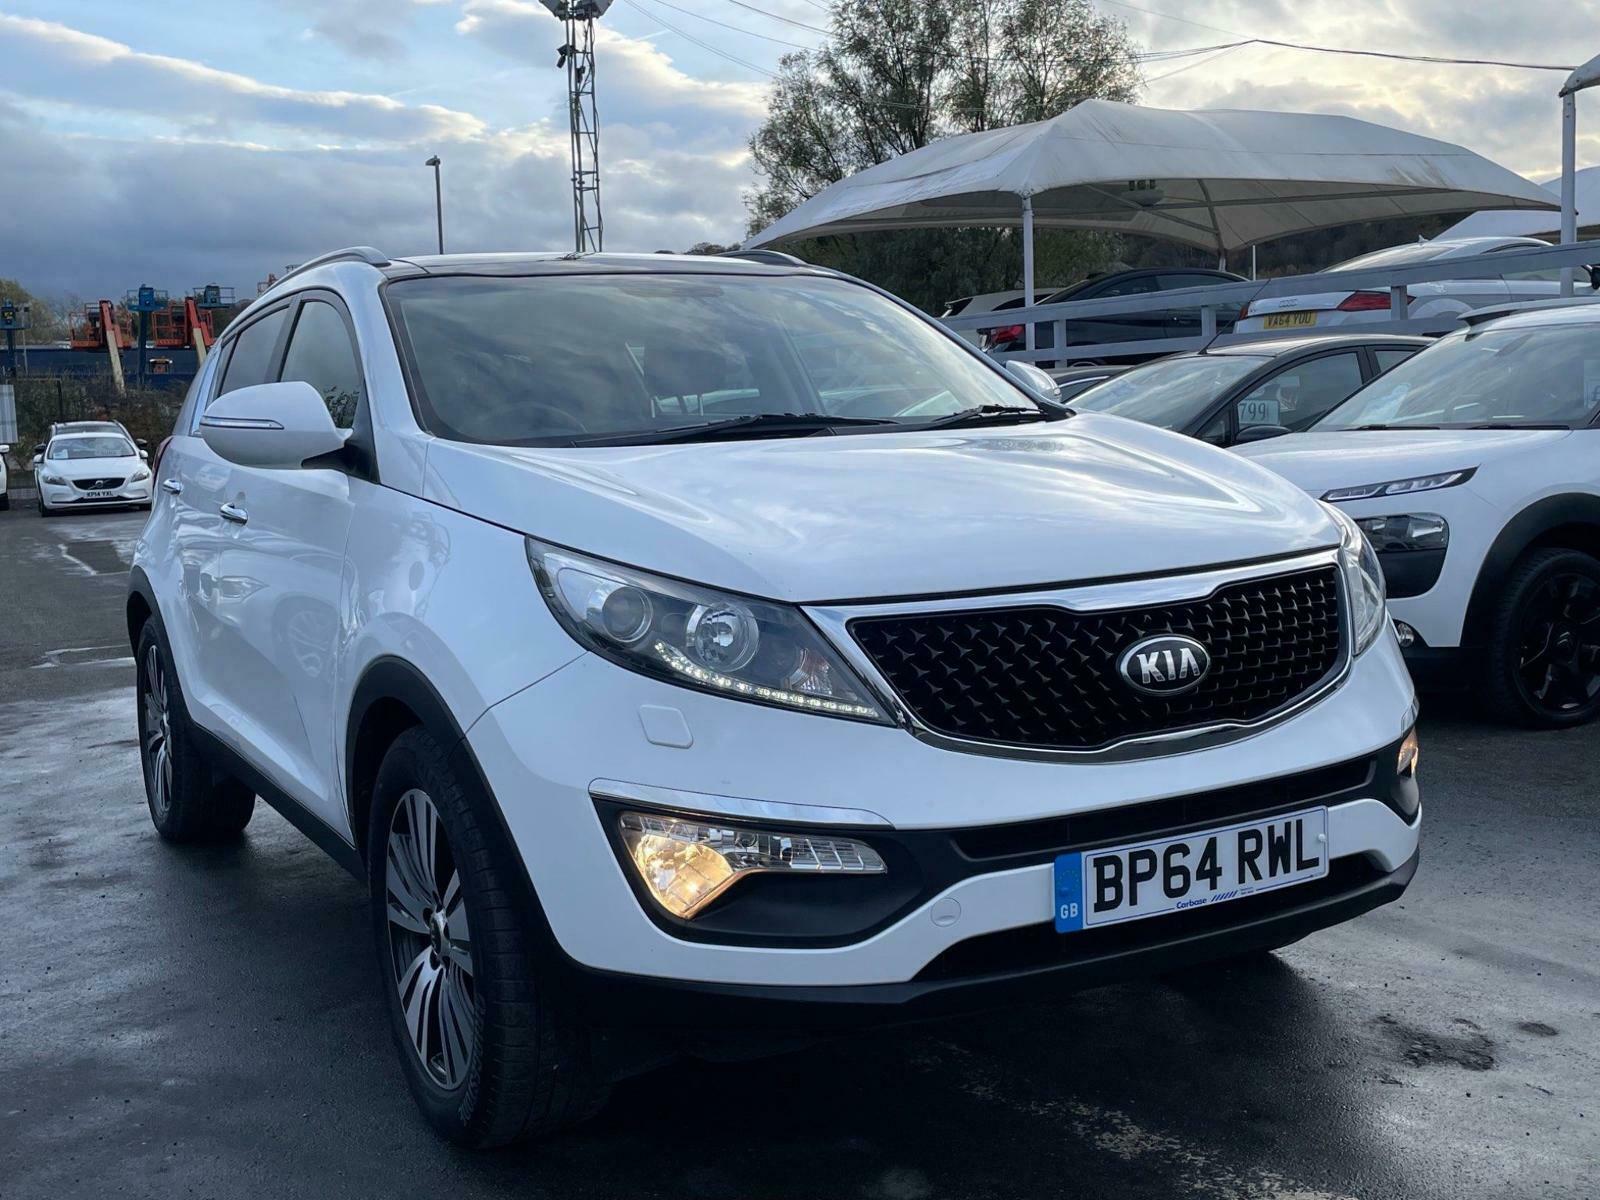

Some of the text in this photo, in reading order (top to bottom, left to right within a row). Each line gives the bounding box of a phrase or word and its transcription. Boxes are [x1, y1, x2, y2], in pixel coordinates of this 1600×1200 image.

[1136, 647, 1201, 684] KIA
[1093, 818, 1320, 913] BP64 RWL
[1060, 902, 1079, 919] GB
[1176, 897, 1208, 909] Carbase
